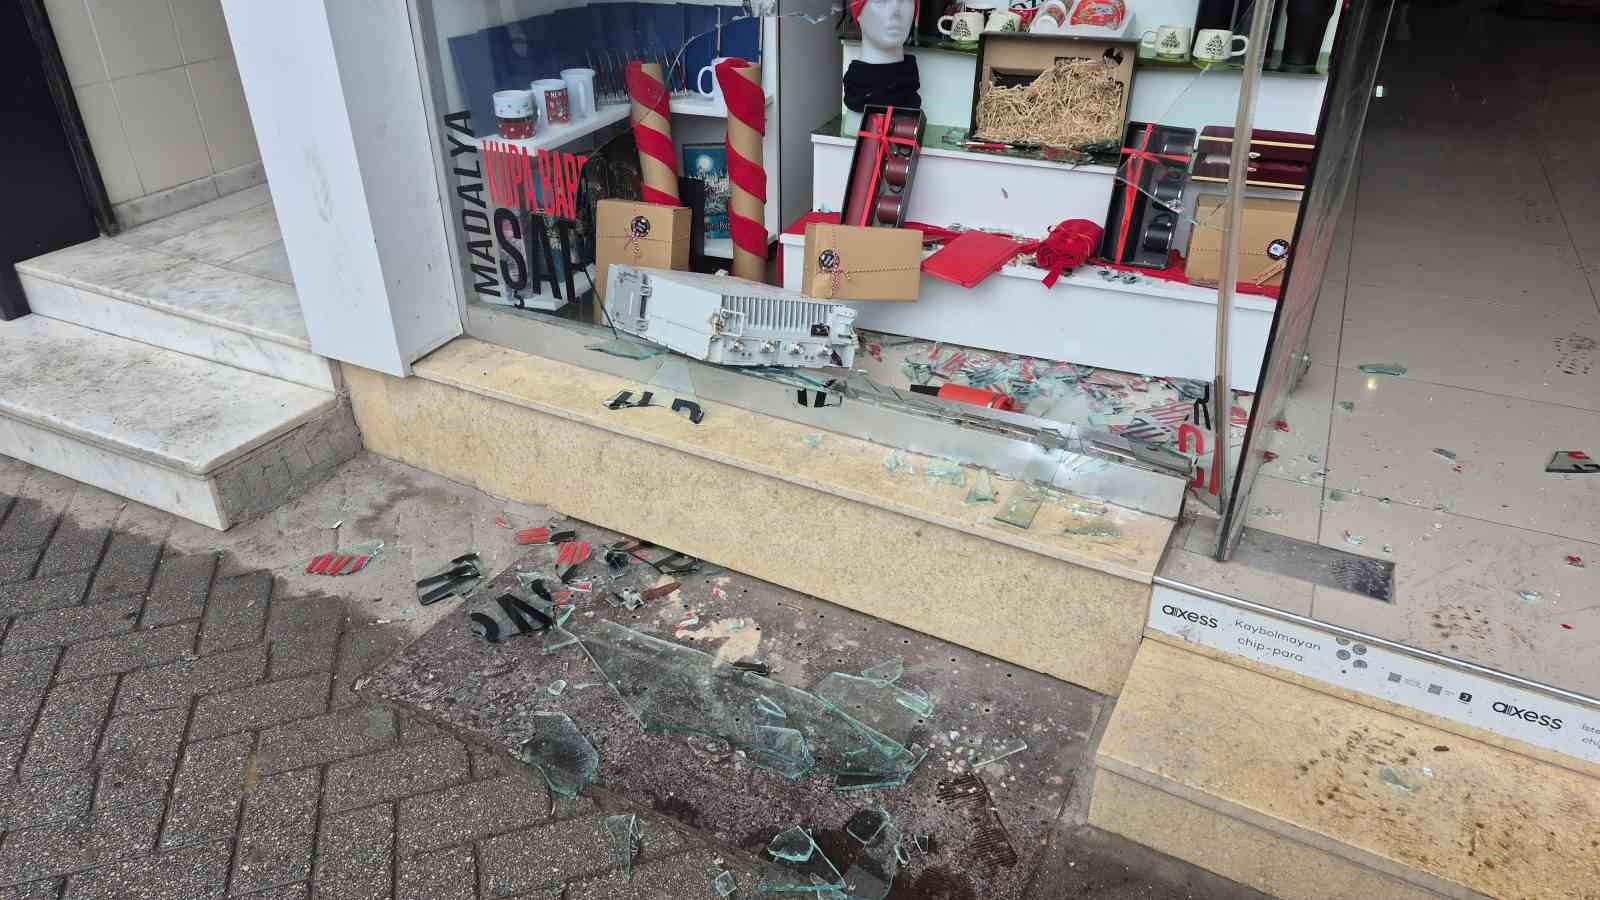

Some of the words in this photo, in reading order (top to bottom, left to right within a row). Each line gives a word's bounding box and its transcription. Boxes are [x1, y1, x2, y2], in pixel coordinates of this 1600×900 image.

[444, 110, 502, 298] MADALYA
[1162, 604, 1219, 629] axess
[1234, 619, 1321, 651] Kaybolmayan
[1492, 701, 1563, 730] axess
